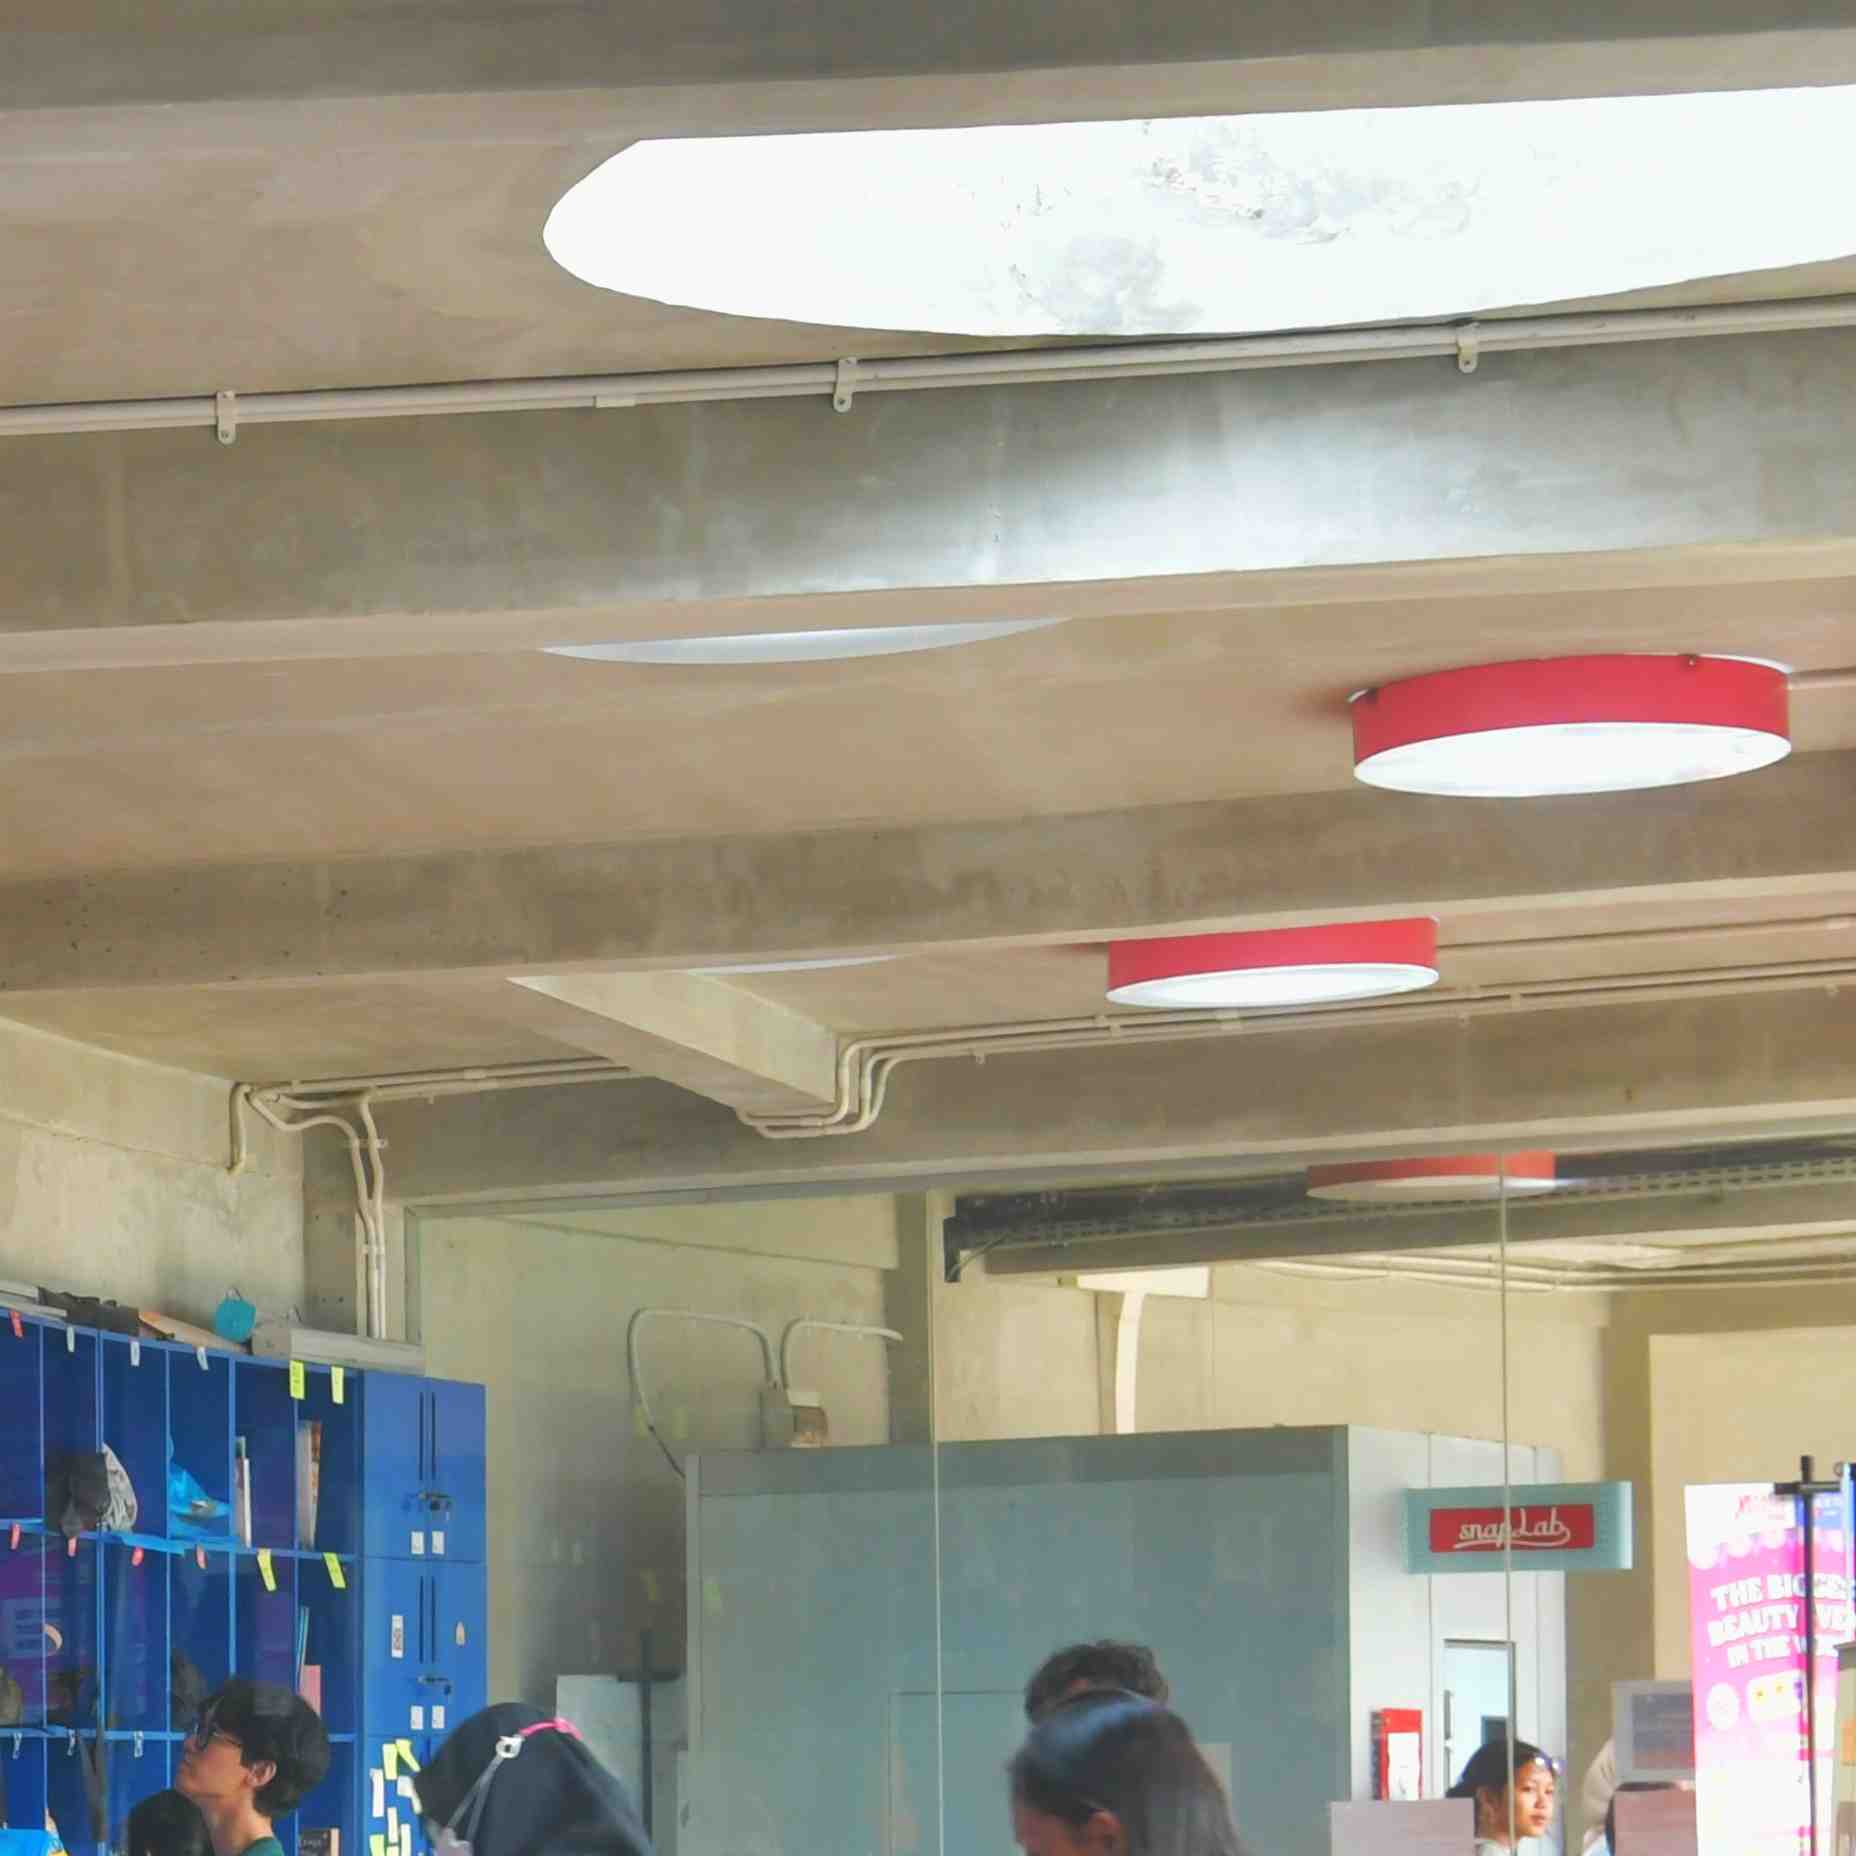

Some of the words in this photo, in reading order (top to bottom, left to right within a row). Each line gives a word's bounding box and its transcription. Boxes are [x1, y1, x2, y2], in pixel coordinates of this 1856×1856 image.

[1711, 1577, 1763, 1611] THE
[1708, 1604, 1798, 1647] BEAUTY
[1726, 1644, 1749, 1669] IN
[1750, 1634, 1792, 1660] THE
